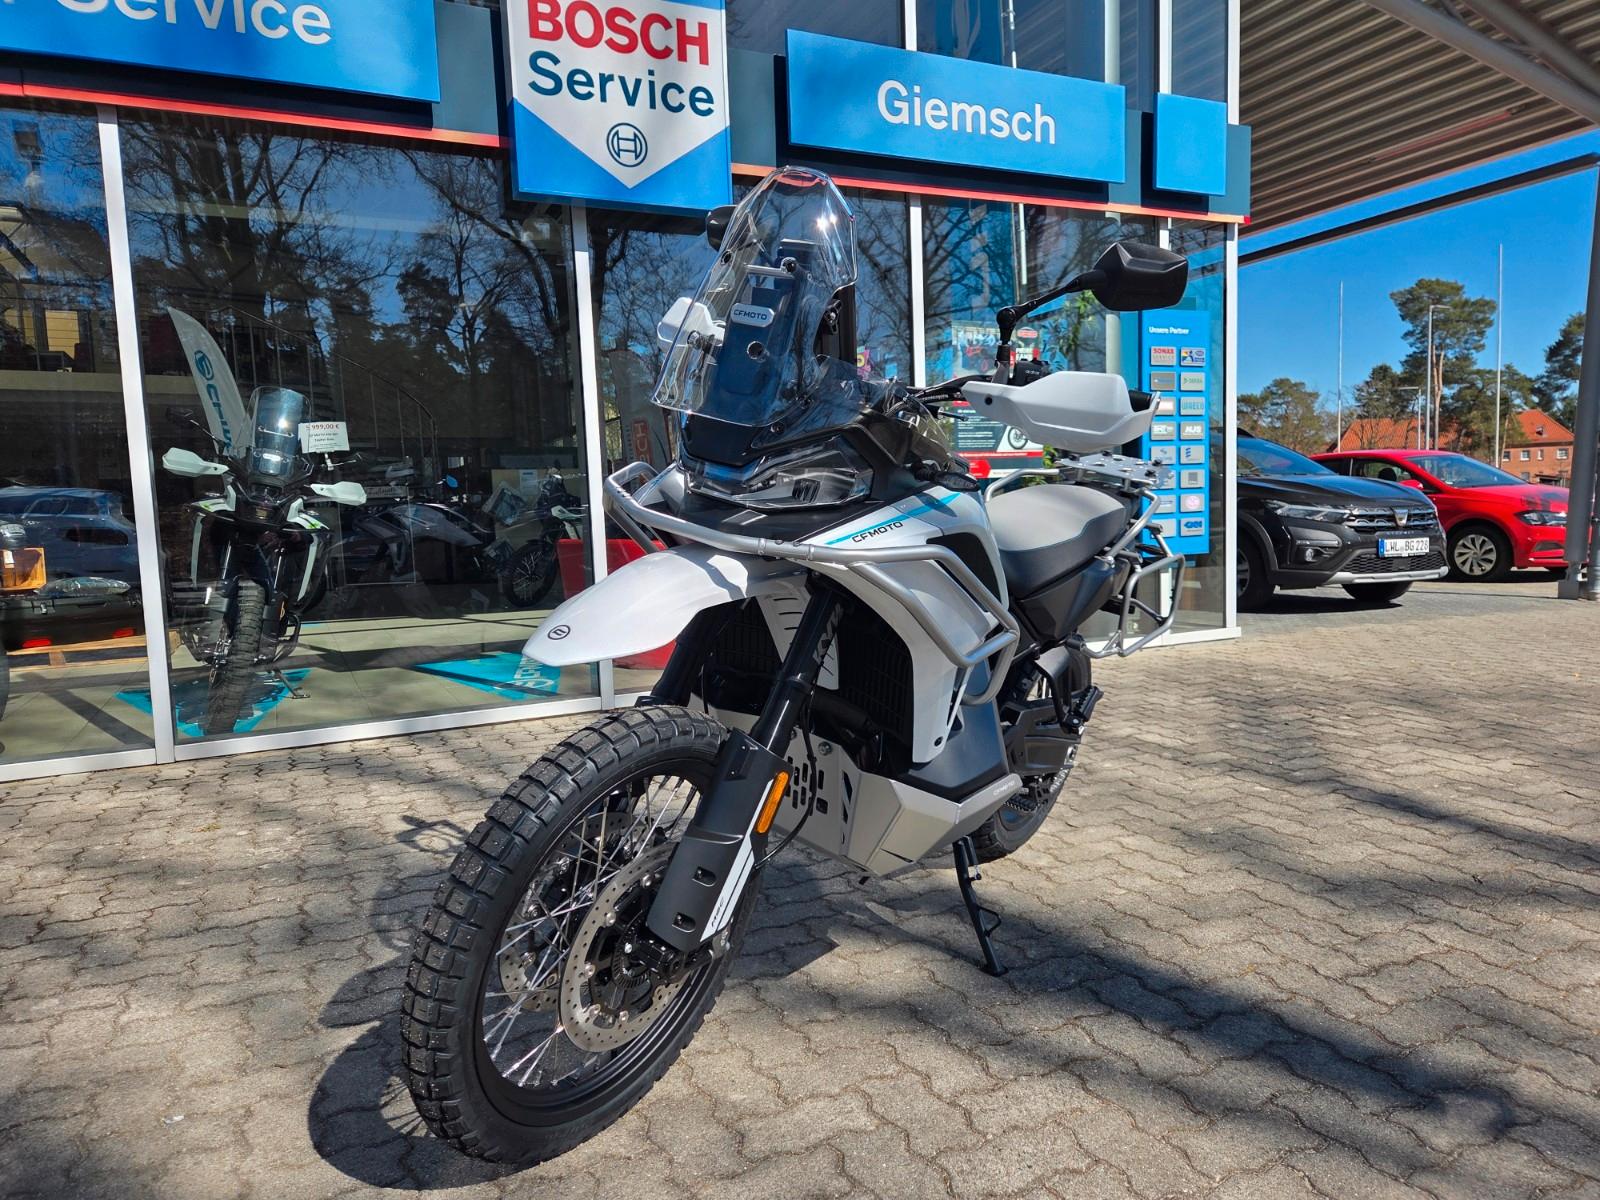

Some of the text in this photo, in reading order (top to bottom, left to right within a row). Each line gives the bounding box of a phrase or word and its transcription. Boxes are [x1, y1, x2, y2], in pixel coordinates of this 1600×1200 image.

[56, 0, 332, 45] rvice
[527, 0, 710, 66] BOSCH
[528, 50, 715, 117] Service
[877, 79, 1056, 145] Giemsch
[733, 309, 768, 321] CFMOTO
[851, 521, 904, 543] CFMOTO
[1385, 540, 1400, 552] LWL
[1404, 540, 1415, 551] BG
